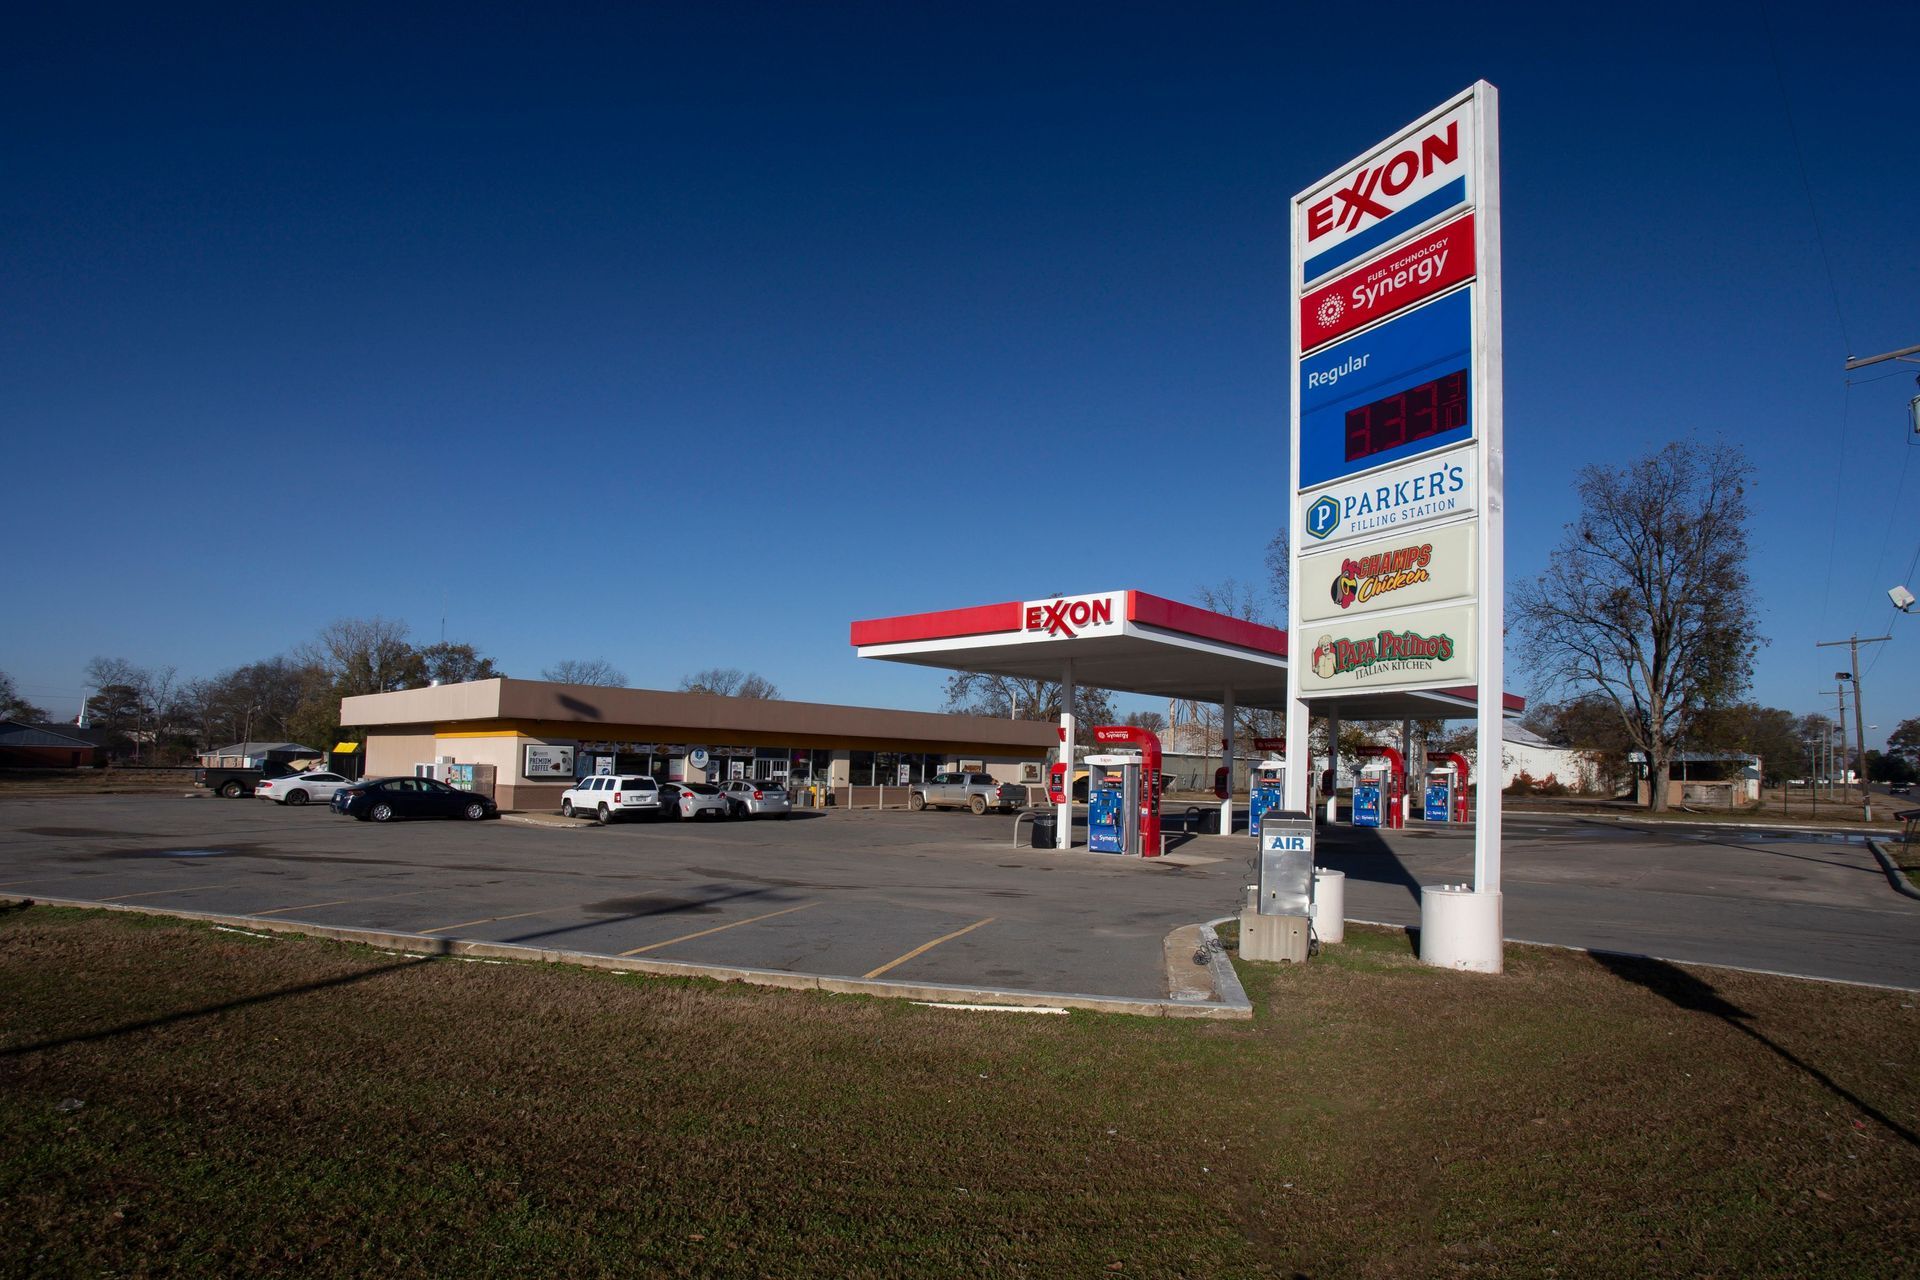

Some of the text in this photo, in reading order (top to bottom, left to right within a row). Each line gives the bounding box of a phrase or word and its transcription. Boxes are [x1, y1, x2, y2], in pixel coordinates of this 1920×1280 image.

[1308, 120, 1458, 243] EXXON
[1367, 237, 1449, 284] FUEL TECHNOLOGY
[1352, 249, 1449, 309] Synergy
[1308, 354, 1370, 389] Regular
[1343, 462, 1464, 519] PARKER'S
[1316, 504, 1331, 531] P
[1351, 497, 1456, 533] FILLING STATION
[1357, 544, 1433, 579] CHAMPS
[1358, 568, 1430, 603] Chicken
[1025, 598, 1112, 638] EXXON
[1355, 661, 1433, 680] ITALIAN KITCHEN
[1271, 836, 1304, 850] AIR
